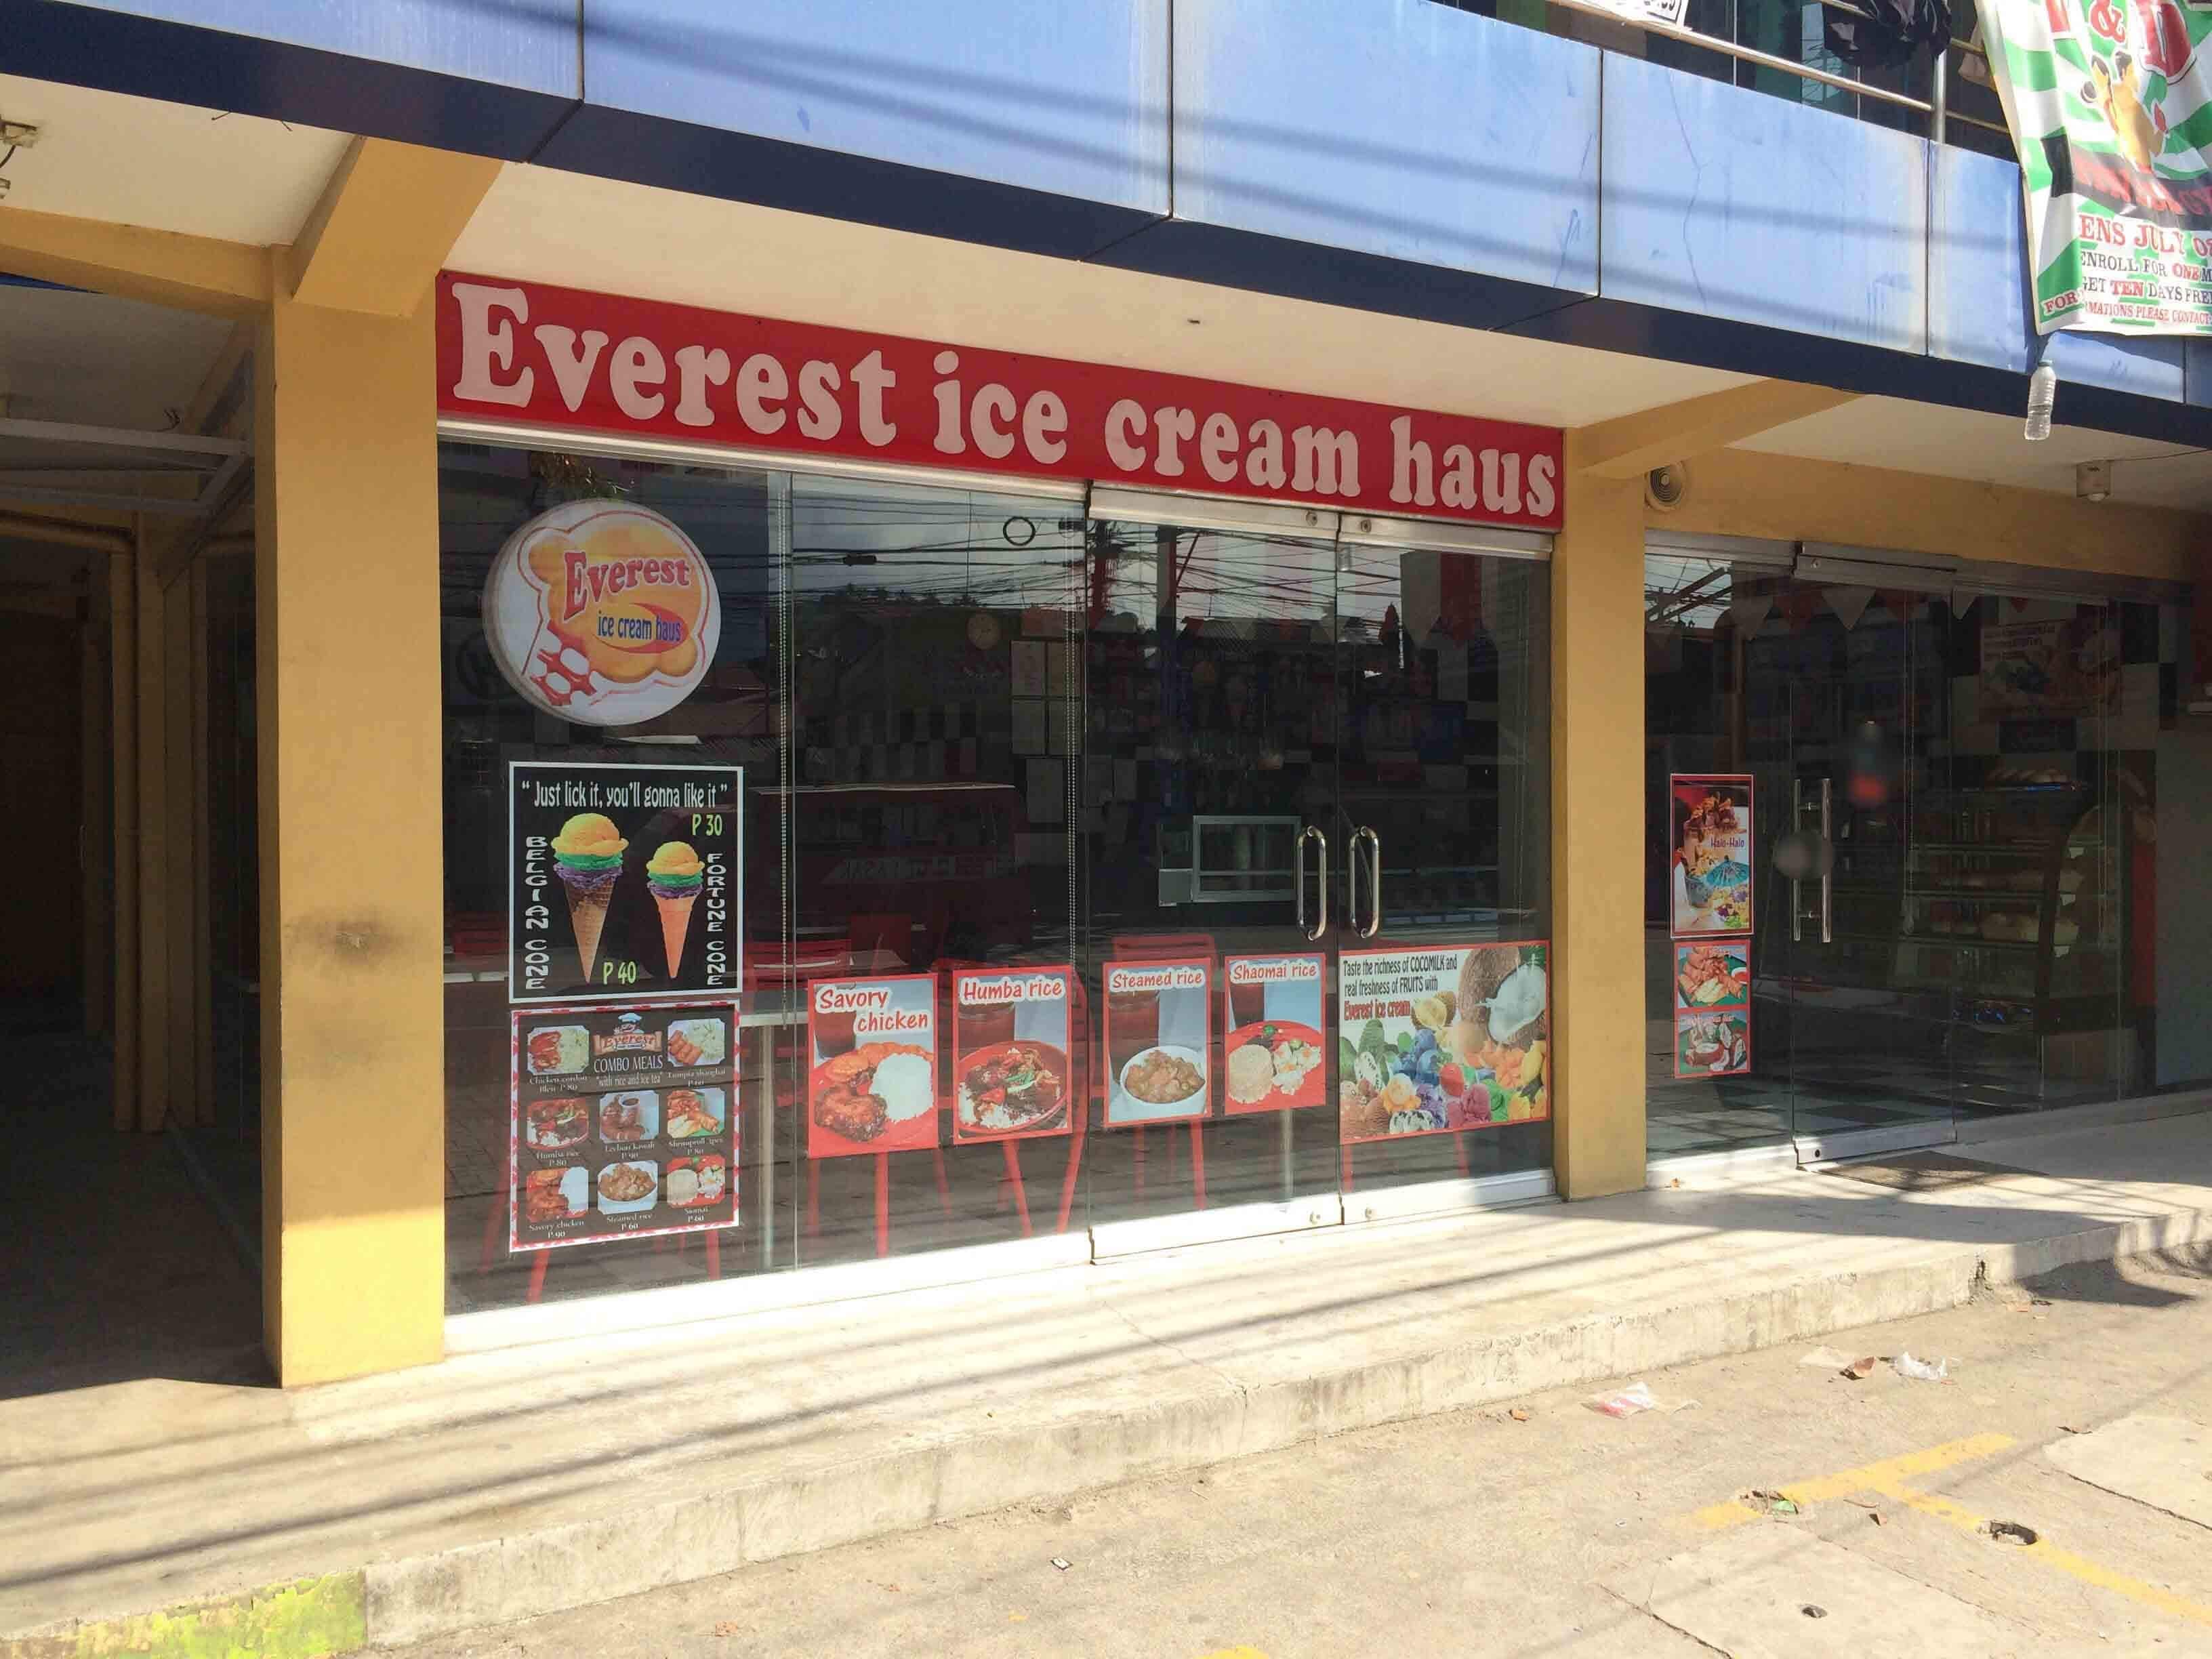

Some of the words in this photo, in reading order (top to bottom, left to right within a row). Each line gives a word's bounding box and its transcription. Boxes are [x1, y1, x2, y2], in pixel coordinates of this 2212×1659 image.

[2079, 215, 2126, 245] ENS
[2135, 225, 2184, 254] JULY
[2144, 259, 2168, 276] FOR
[2172, 262, 2199, 281] ONE
[2110, 280, 2144, 295] TEN
[2149, 283, 2182, 302] DAYS
[2045, 292, 2078, 313] FOR
[2136, 304, 2169, 321] PLEASE
[452, 282, 897, 446] Everest
[933, 350, 1069, 464] ice
[1104, 398, 1360, 497] cream
[1390, 415, 1555, 517] haus
[564, 551, 691, 621] Everest
[598, 611, 614, 638] ice
[617, 617, 652, 640] cream
[655, 615, 681, 641] haus
[534, 781, 560, 807] Just
[565, 781, 586, 806] lick
[590, 783, 602, 808] it,
[644, 786, 680, 808] gonna
[684, 783, 704, 808] like
[708, 783, 716, 808] it
[692, 814, 701, 836] P
[706, 814, 722, 836] 30
[525, 836, 549, 929] BELGIAN
[707, 853, 726, 932] FORTUNE
[525, 939, 550, 989] CONE
[602, 962, 613, 984] P
[617, 961, 636, 983] 40
[707, 941, 726, 985] CONE
[1233, 964, 1287, 980] Shaomai
[1292, 963, 1317, 977] rice
[1344, 960, 1361, 976] Taste
[1363, 960, 1373, 975] the
[1374, 958, 1401, 975] richness
[1402, 956, 1410, 972] of
[1410, 954, 1445, 972] COCOMILK
[1446, 954, 1457, 970] and
[963, 979, 1022, 1000] Humba
[1029, 979, 1063, 998] rice
[1113, 970, 1172, 989] Steamed
[1177, 971, 1202, 985] rice
[1345, 979, 1357, 997] real
[1359, 979, 1389, 996] freshness
[1392, 977, 1399, 994] of
[1399, 976, 1423, 992] FRUITS
[1425, 976, 1438, 991] with
[819, 988, 889, 1009] Savory
[1344, 1000, 1372, 1020] Everest
[1375, 999, 1387, 1018] ice
[1387, 1000, 1410, 1017] cream
[857, 1010, 928, 1032] chicken
[594, 1057, 630, 1073] COMBO
[633, 1054, 663, 1070] MEALS
[628, 1072, 639, 1085] and
